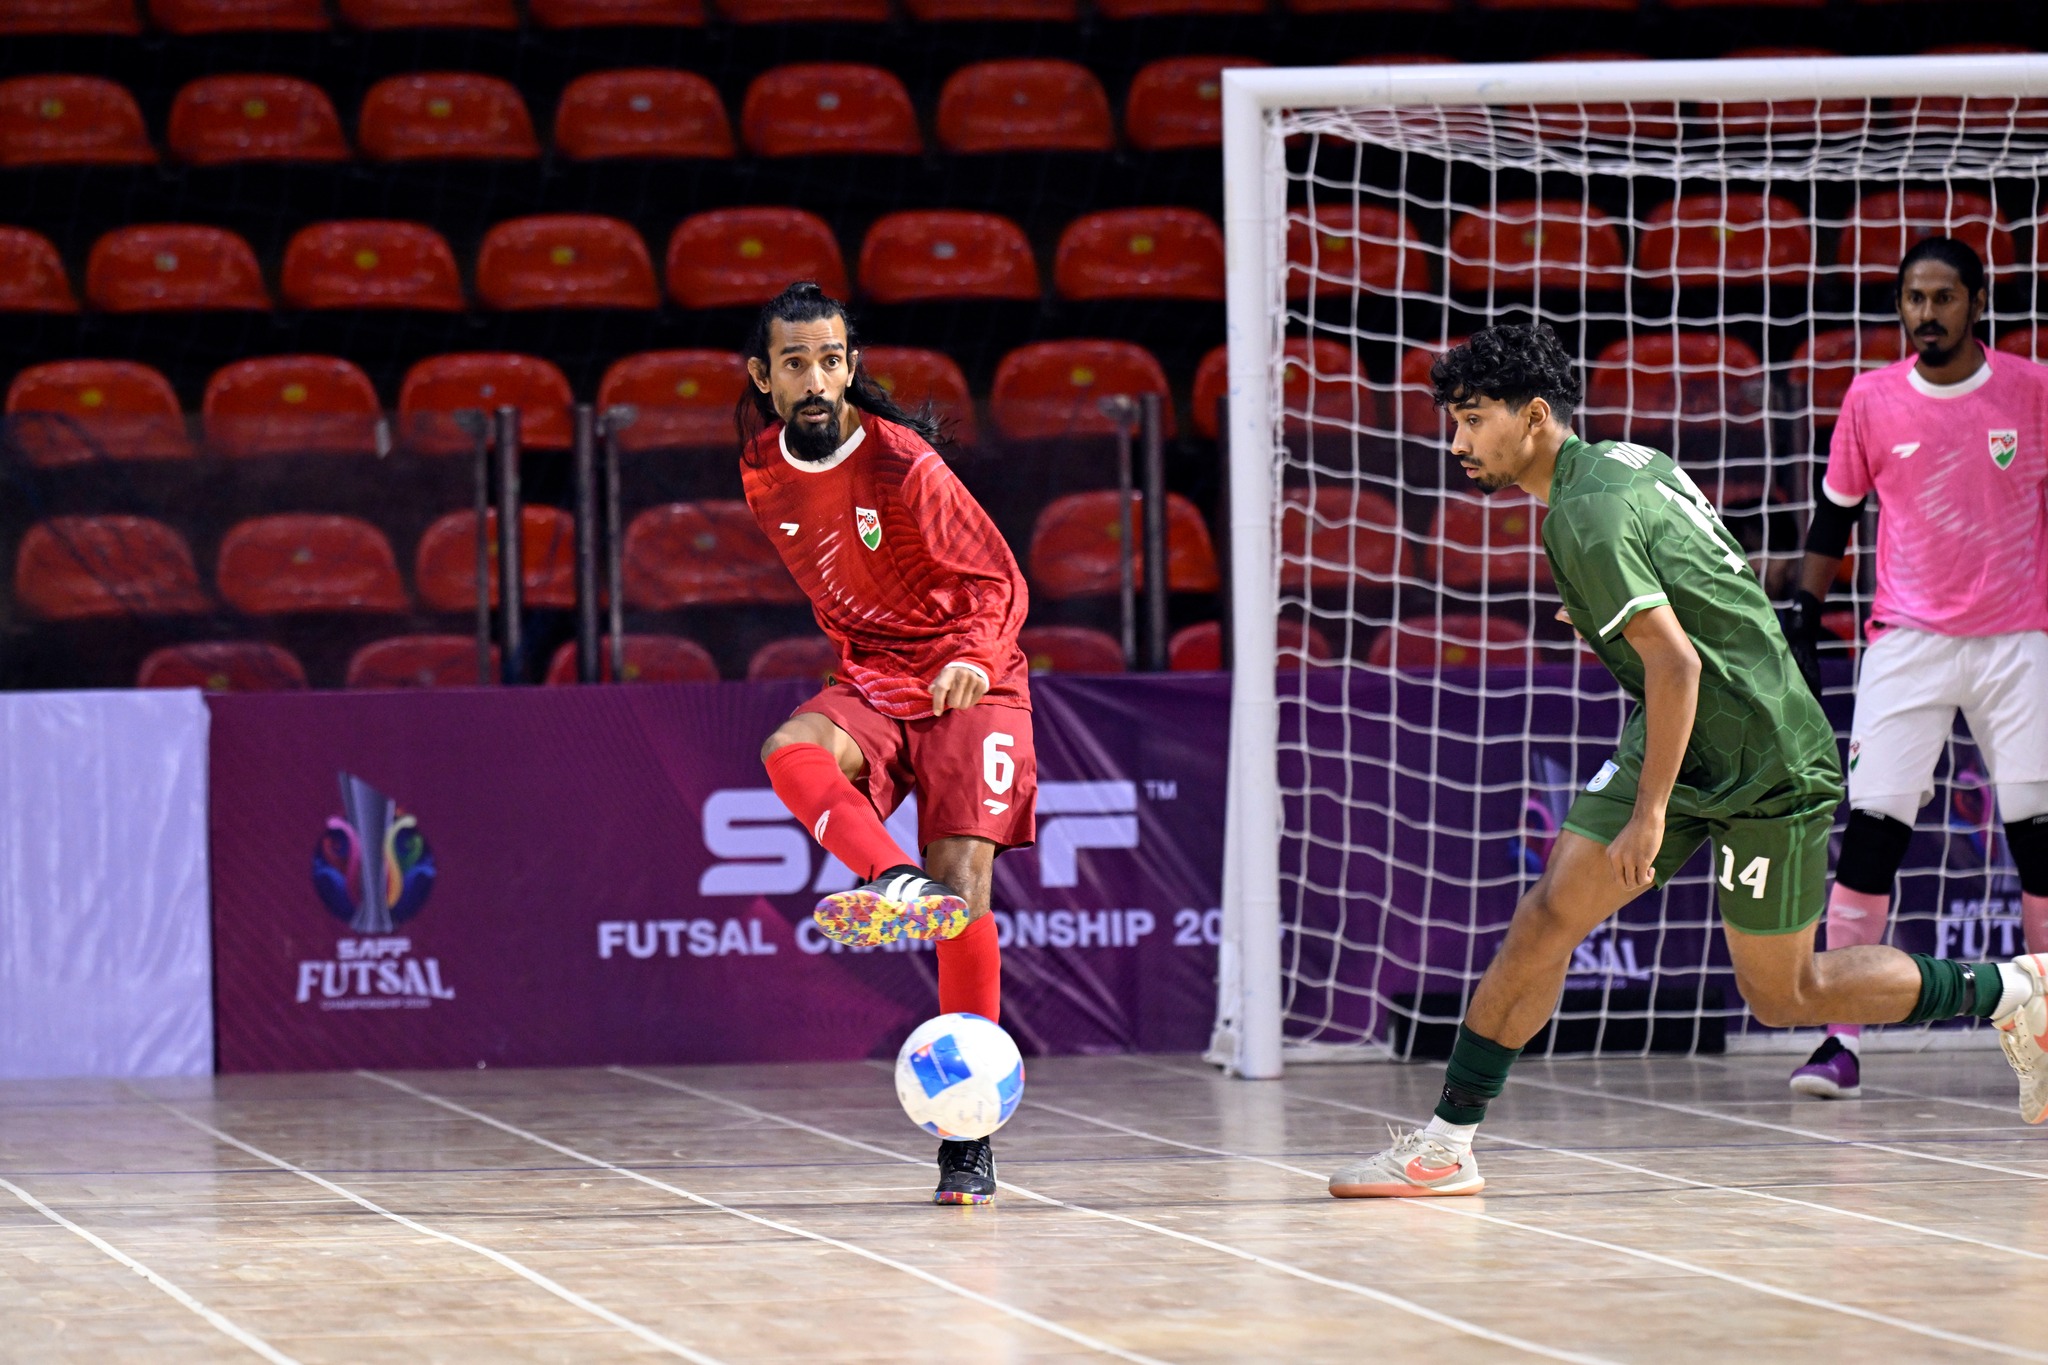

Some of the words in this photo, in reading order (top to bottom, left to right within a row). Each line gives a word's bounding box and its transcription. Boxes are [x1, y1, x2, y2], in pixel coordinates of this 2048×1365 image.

[983, 731, 1015, 795] 6
[699, 780, 1139, 897] SF
[1718, 844, 1770, 899] 14
[598, 918, 777, 959] FUTSAL
[794, 907, 1156, 954] CONSHIP
[1172, 907, 1222, 946] 20
[1935, 916, 2022, 961] FUT
[296, 957, 456, 1004] FUTSAL
